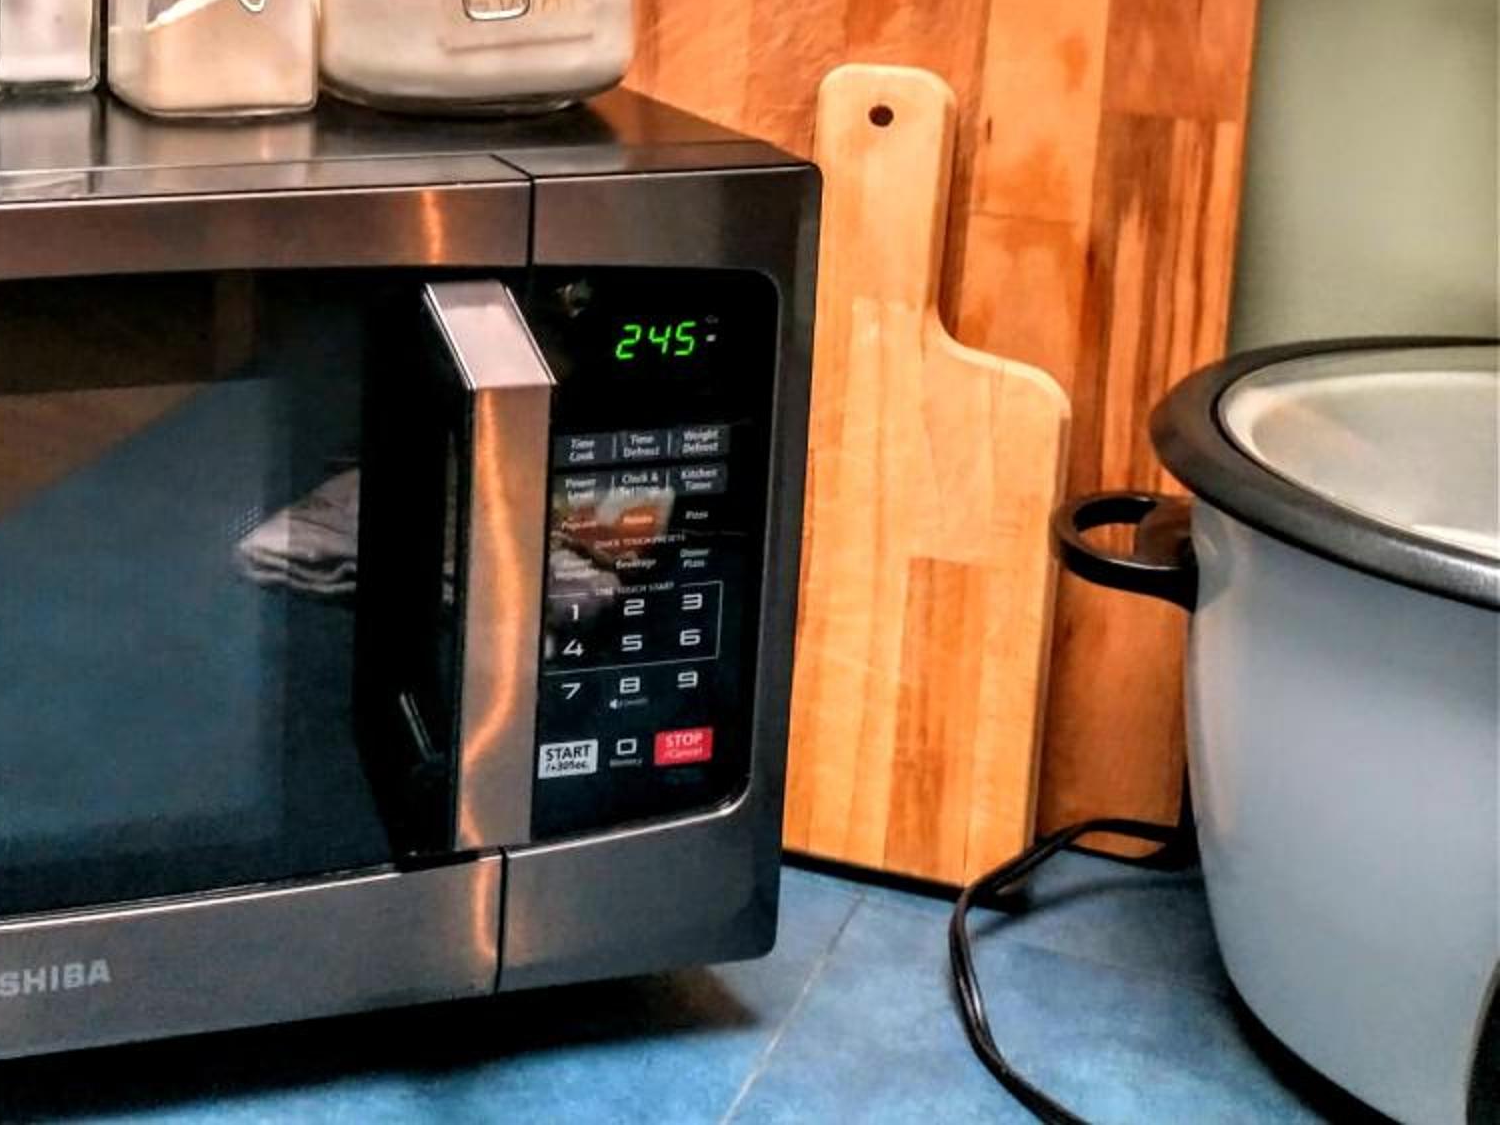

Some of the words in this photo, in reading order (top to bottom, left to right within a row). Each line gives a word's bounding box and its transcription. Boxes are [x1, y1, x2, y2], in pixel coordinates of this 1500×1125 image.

[623, 598, 645, 616] 2
[681, 593, 703, 610] 3
[571, 603, 579, 621] 1
[621, 634, 643, 652] 5
[679, 628, 702, 646] 6
[562, 639, 584, 657] 4
[619, 676, 641, 694] 8
[677, 671, 698, 688] 9
[561, 682, 581, 699] 7
[665, 732, 704, 748] STOP
[546, 745, 591, 761] START
